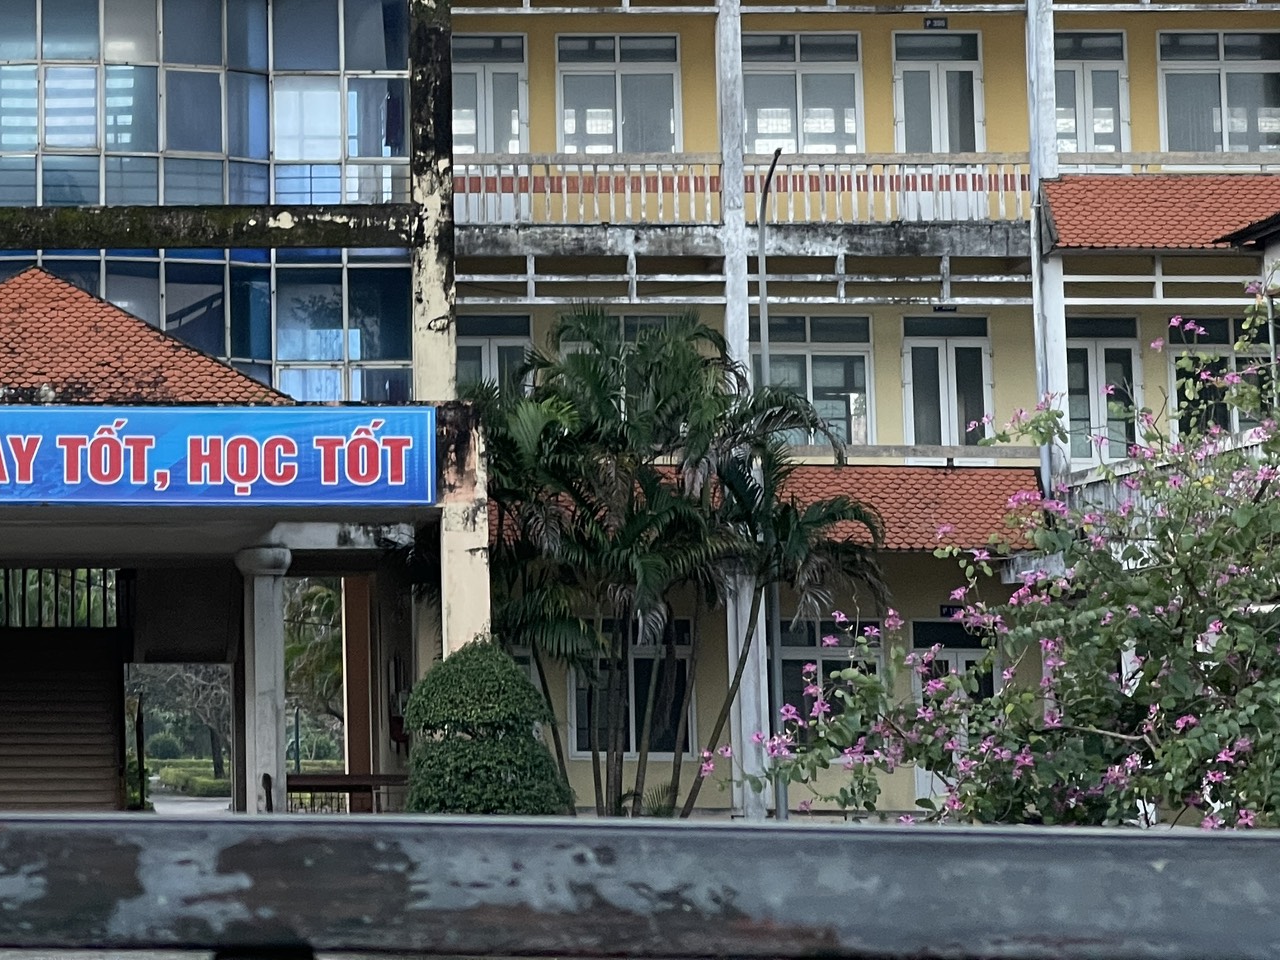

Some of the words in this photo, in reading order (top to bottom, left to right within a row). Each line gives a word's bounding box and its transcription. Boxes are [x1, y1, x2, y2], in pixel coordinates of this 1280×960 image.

[56, 418, 171, 491] TỐT,
[187, 434, 298, 495] HỌC
[314, 418, 412, 486] TỐT
